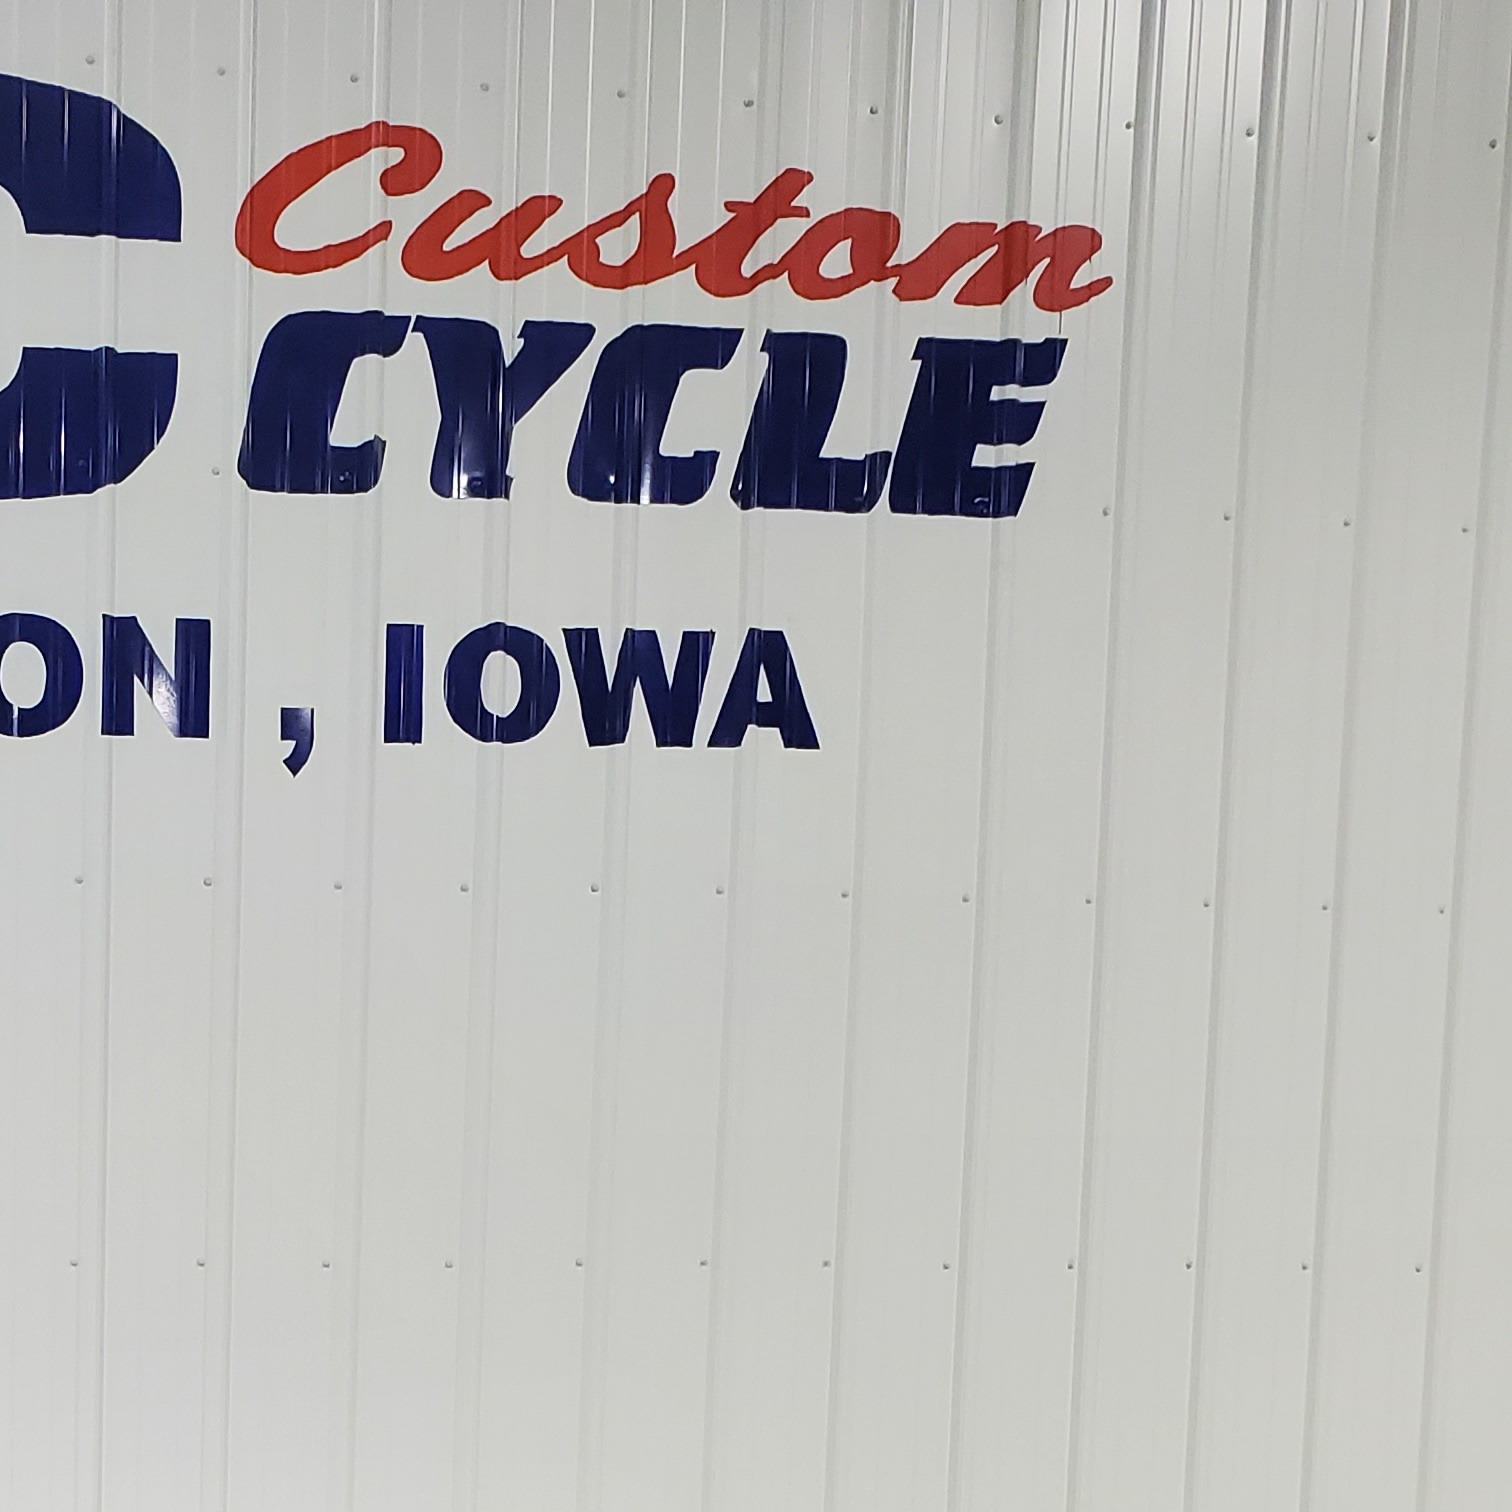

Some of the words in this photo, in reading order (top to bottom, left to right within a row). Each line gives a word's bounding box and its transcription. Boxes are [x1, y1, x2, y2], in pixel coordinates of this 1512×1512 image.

[234, 120, 1113, 313] Custom
[237, 309, 1069, 519] CYCLE
[383, 621, 820, 750] IOWA
